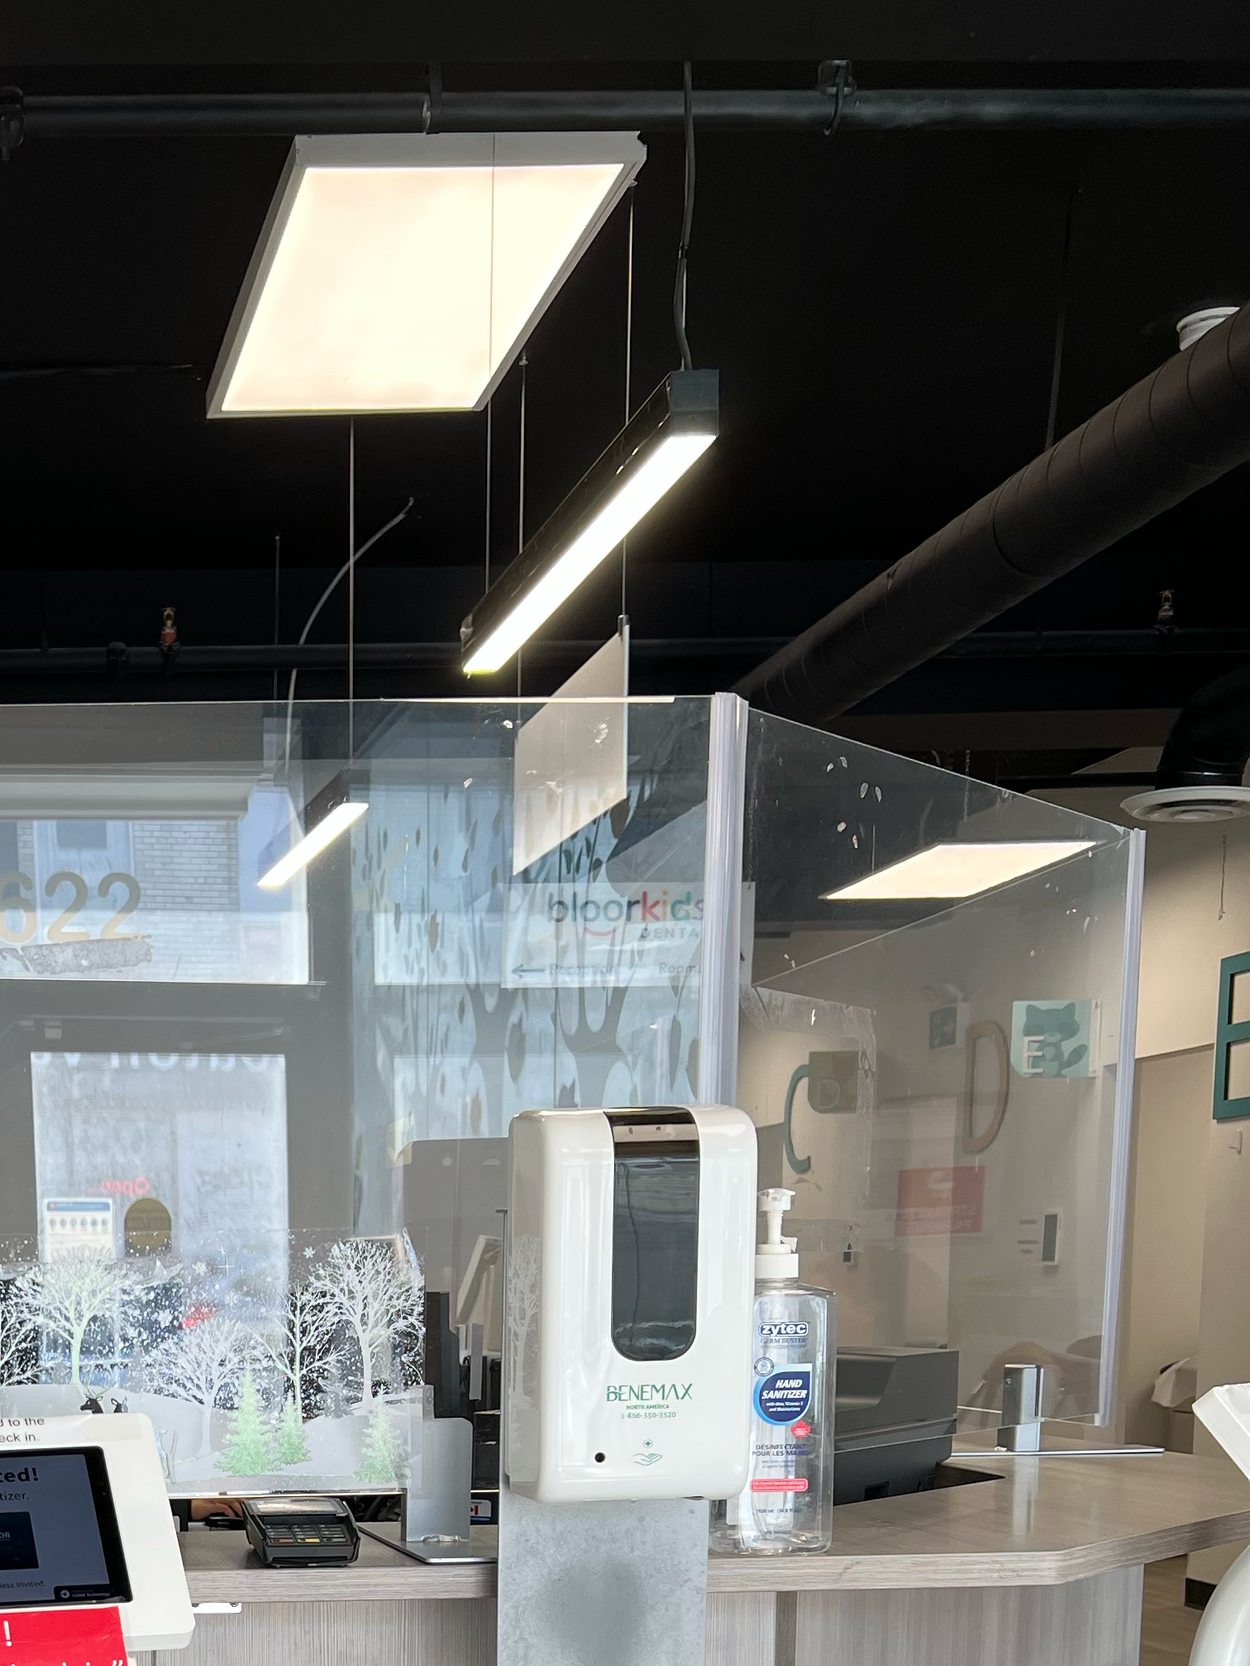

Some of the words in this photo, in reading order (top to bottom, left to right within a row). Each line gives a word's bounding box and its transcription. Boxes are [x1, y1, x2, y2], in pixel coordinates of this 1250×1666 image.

[1022, 1036, 1045, 1075] E
[762, 1323, 807, 1337] zytec
[775, 1379, 802, 1388] HAND
[606, 1383, 692, 1402] BENEMAX
[761, 1390, 807, 1399] SANITIZER
[8, 1418, 21, 1427] to
[25, 1417, 45, 1427] the
[25, 1432, 39, 1442] in.
